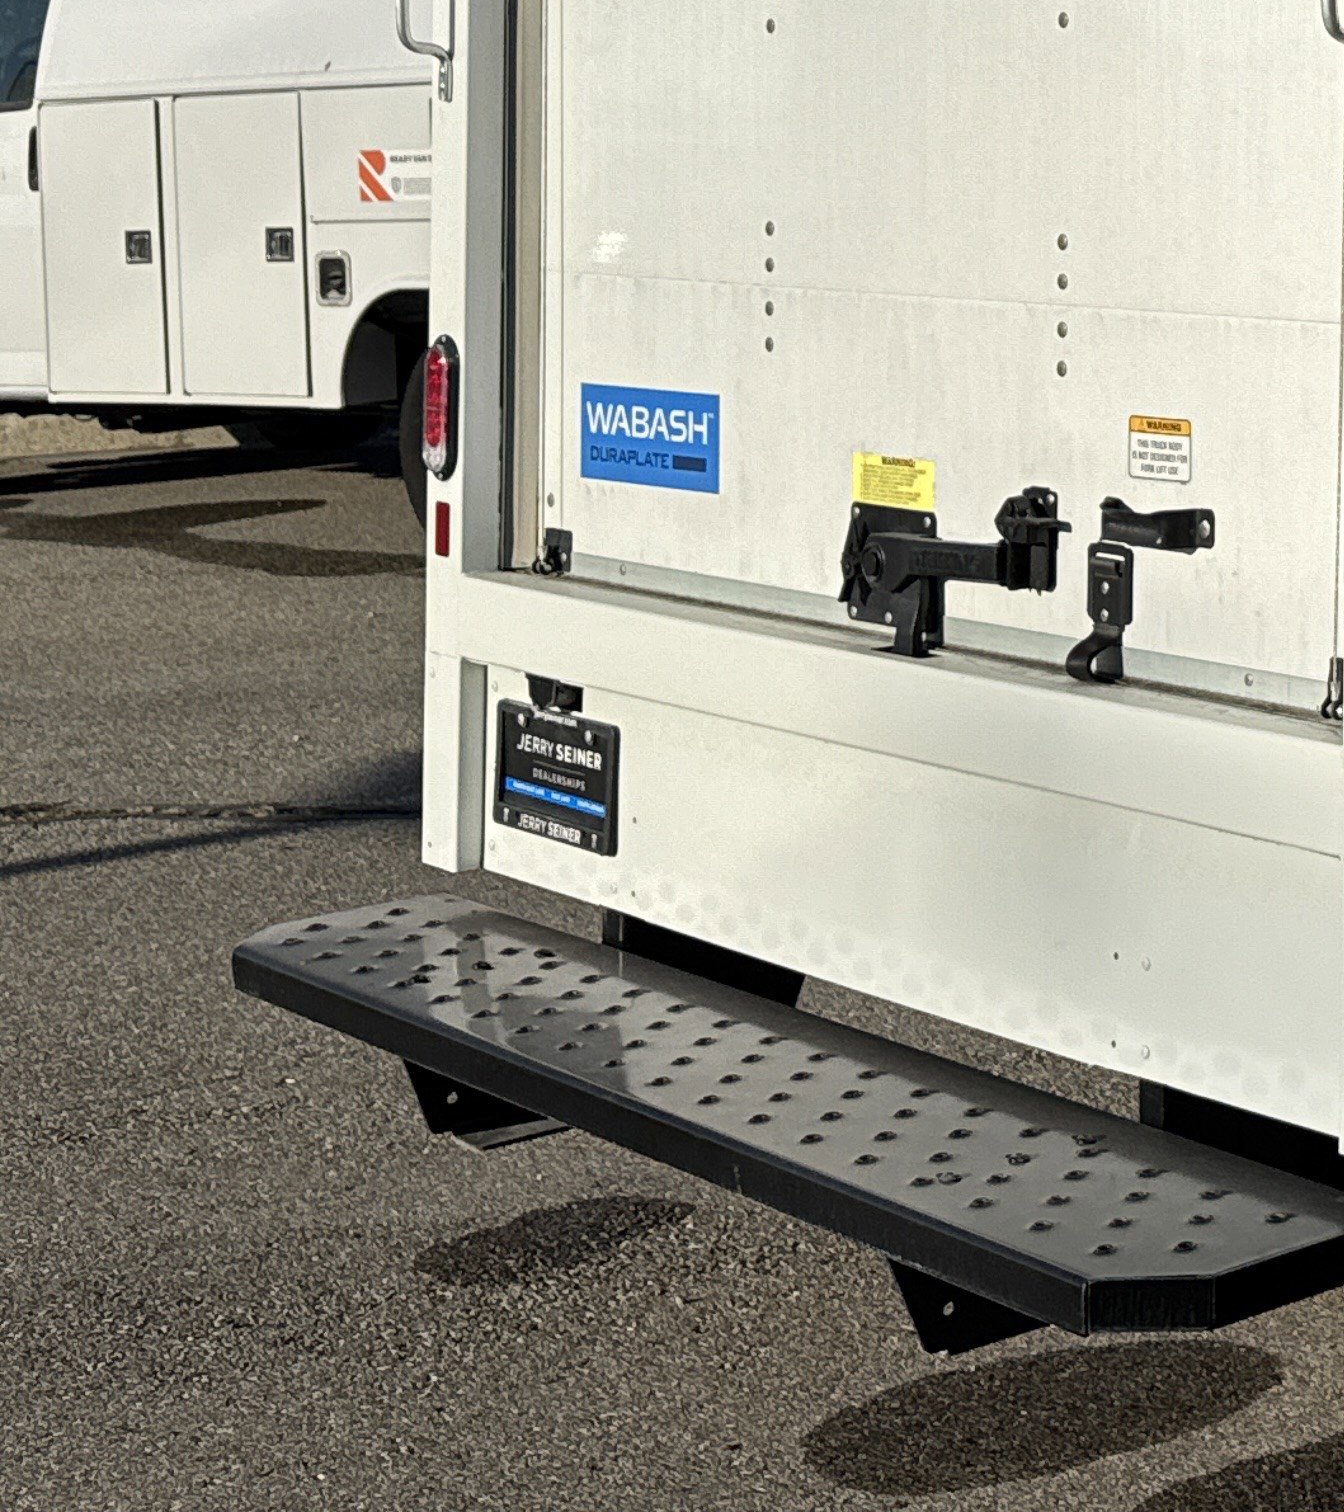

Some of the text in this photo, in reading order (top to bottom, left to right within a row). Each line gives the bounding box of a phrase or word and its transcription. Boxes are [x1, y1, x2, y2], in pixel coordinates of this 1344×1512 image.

[586, 400, 708, 445] WABASH
[590, 445, 670, 469] DURAPLATE
[516, 733, 603, 771] JERRY SEINER
[517, 812, 582, 845] JERRY SEINER
